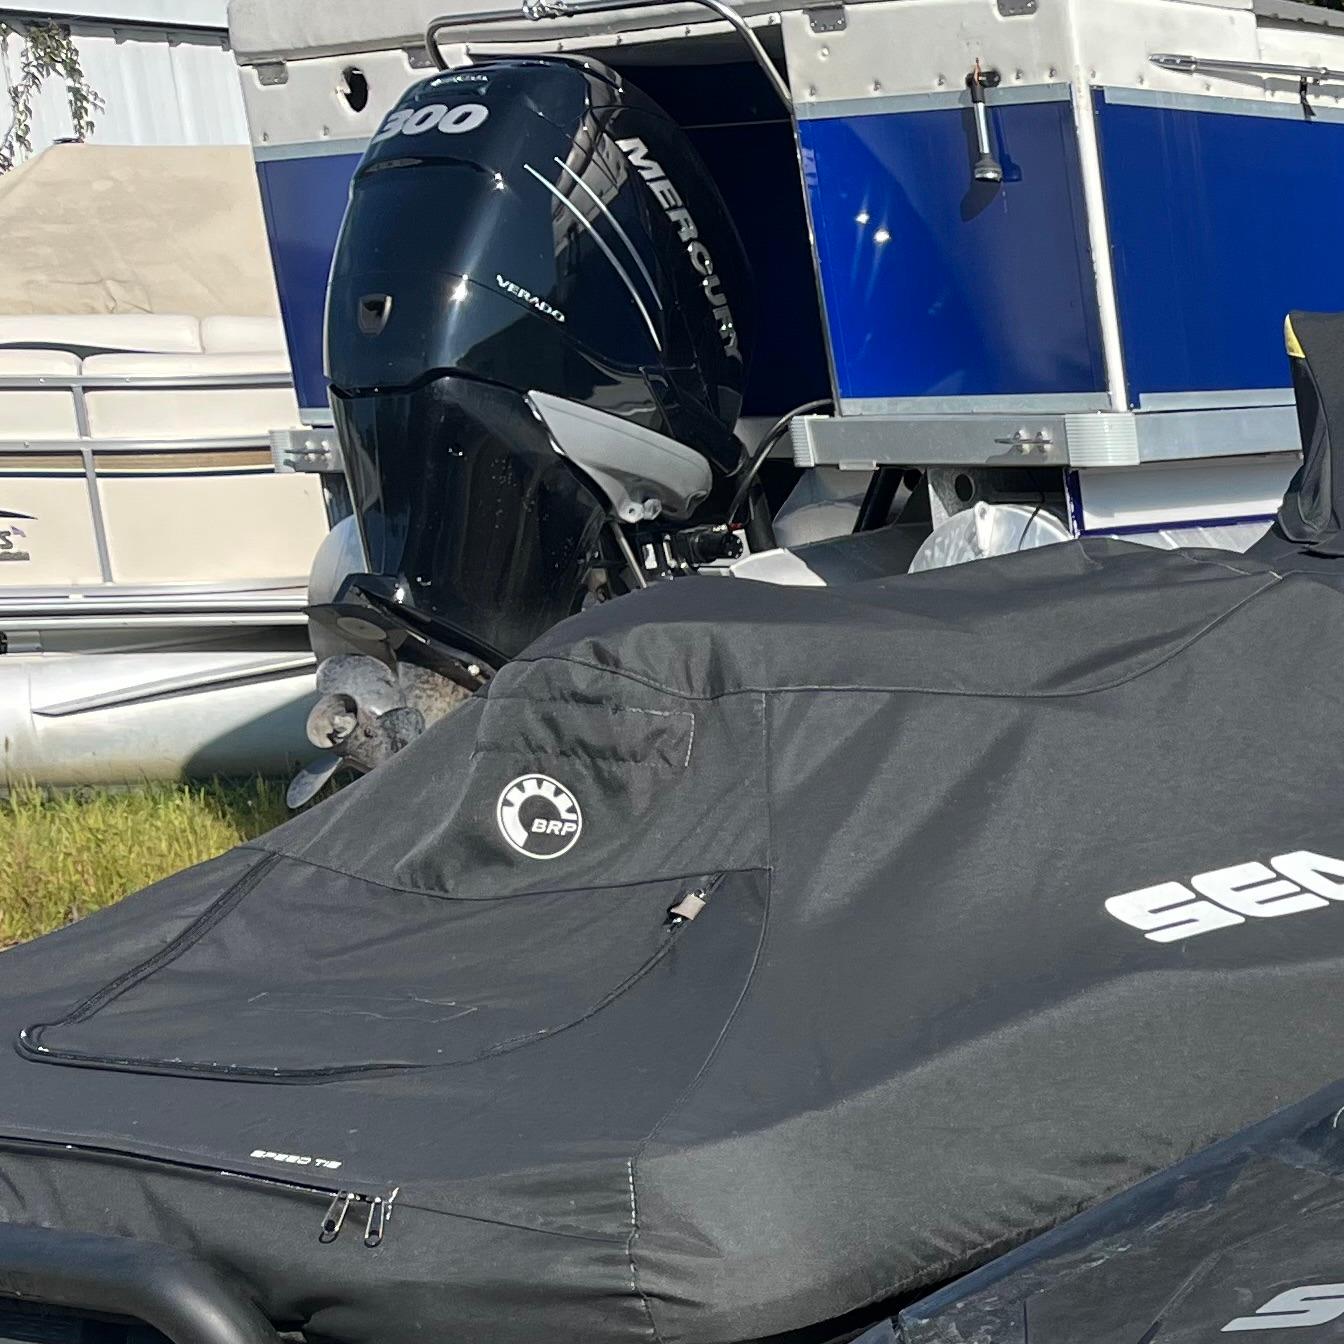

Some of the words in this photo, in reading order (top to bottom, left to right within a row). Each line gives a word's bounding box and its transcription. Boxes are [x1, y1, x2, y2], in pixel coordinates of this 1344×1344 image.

[370, 104, 489, 144] 300
[615, 137, 743, 363] MERCURY
[496, 274, 565, 323] VERADO
[531, 818, 577, 836] BRP
